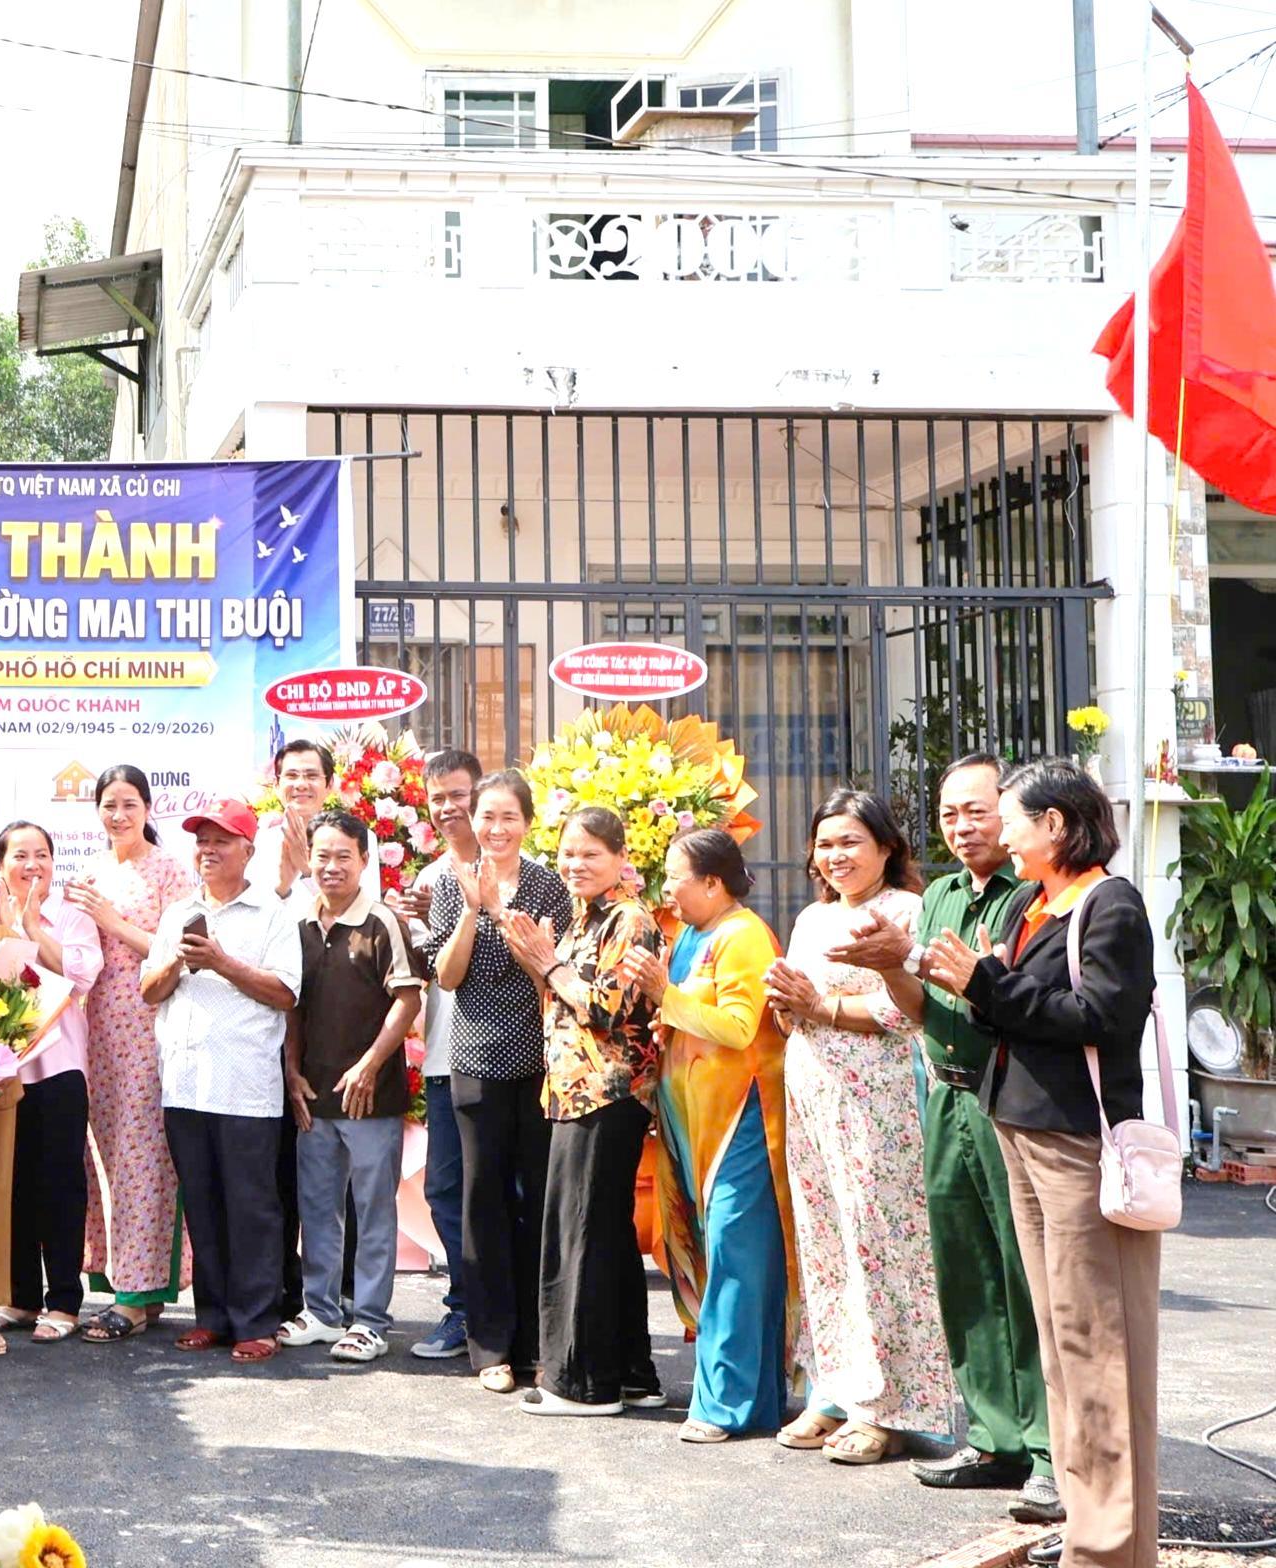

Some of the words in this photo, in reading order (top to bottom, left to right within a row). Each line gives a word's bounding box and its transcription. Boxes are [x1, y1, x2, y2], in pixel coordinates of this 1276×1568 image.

[19, 476, 54, 498] VIỆT
[59, 479, 95, 496] NAM
[99, 475, 122, 496] XÃ
[126, 474, 149, 496] CỦ
[153, 480, 180, 496] CHI
[1, 509, 217, 580] THÀNH
[79, 599, 145, 638] MAI
[156, 599, 211, 648] THỊ
[221, 590, 302, 647] BUỘI
[45, 656, 77, 679] HỒ
[83, 657, 120, 679] CHÍ
[128, 662, 185, 679] MINH
[276, 683, 304, 700] CHI
[309, 679, 332, 702] BỘ
[337, 681, 370, 697] BND
[375, 675, 397, 695] ẤP
[401, 679, 411, 695] 5
[17, 695, 70, 713] QUỐC
[76, 697, 140, 712] KHÁNH
[36, 721, 115, 736] (02/9/1945
[132, 722, 214, 736] 02/9/2026)
[151, 771, 190, 790] DỰNG
